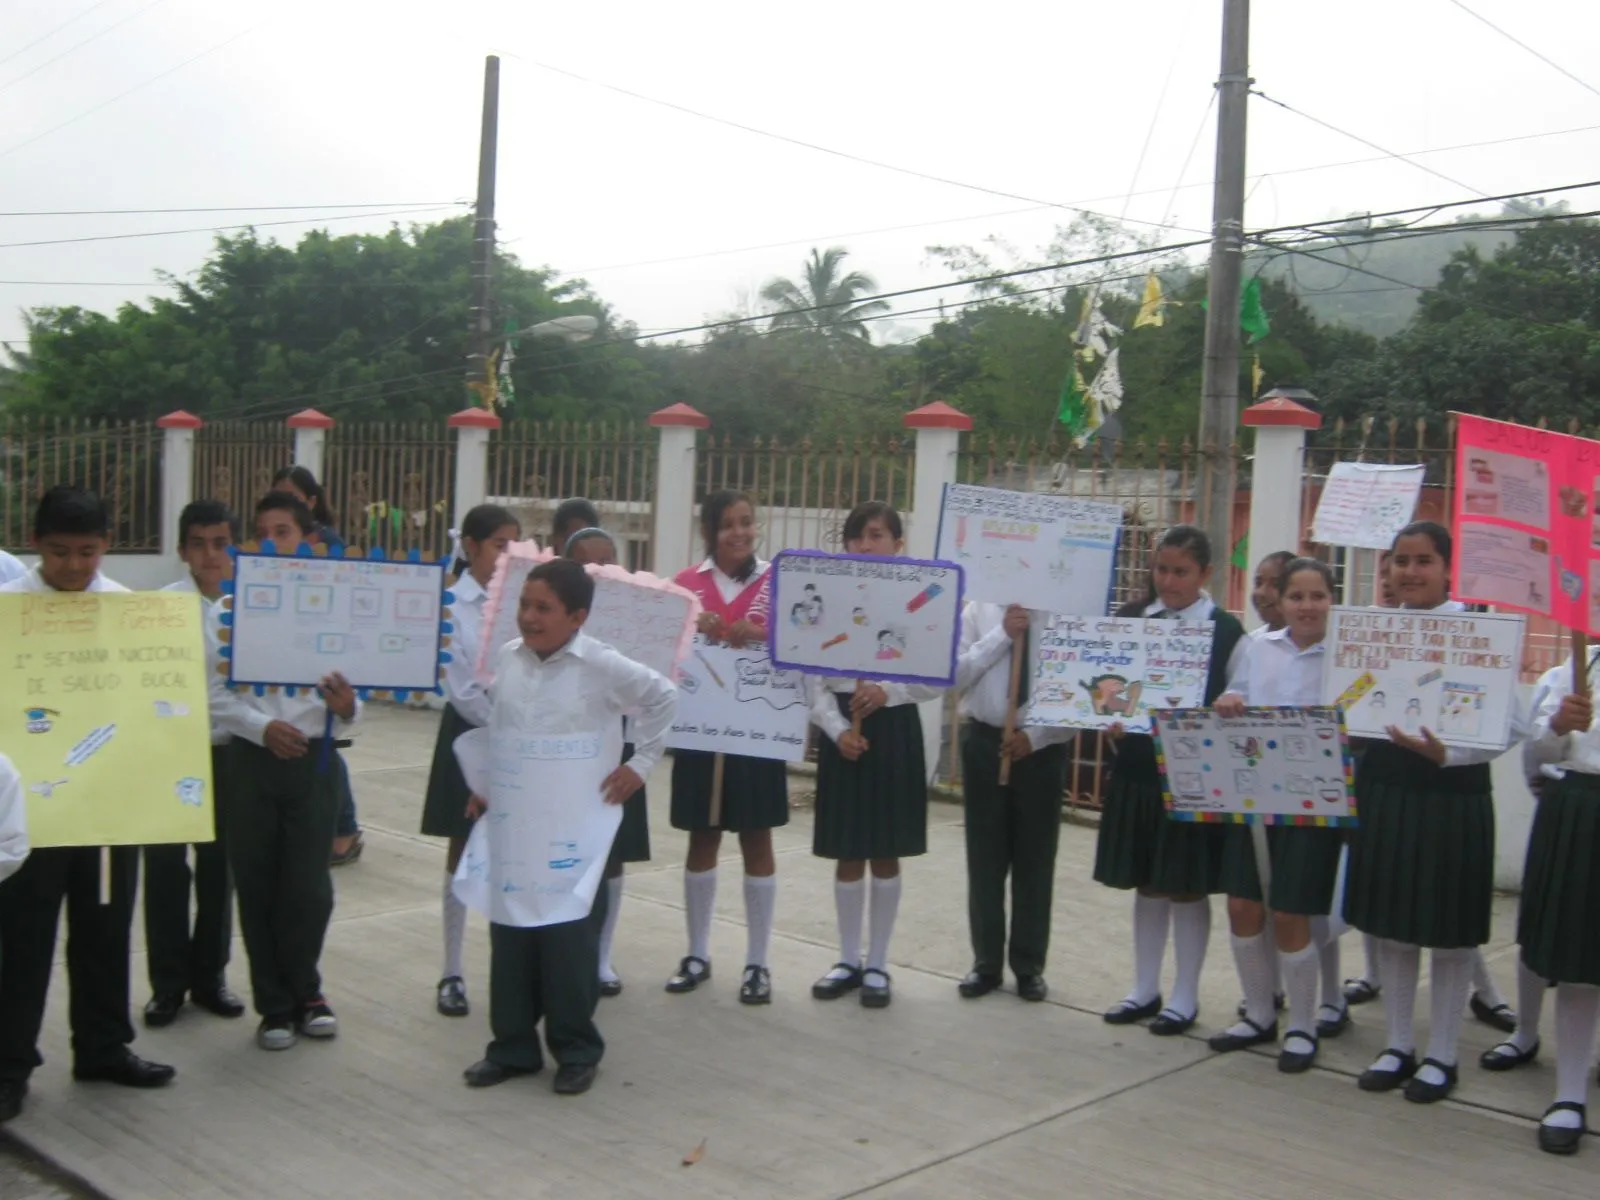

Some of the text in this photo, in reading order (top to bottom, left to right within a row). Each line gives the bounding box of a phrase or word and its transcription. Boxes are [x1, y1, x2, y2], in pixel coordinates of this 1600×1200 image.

[1096, 617, 1134, 634] entre
[1143, 620, 1165, 636] los
[1338, 614, 1382, 630] VISITE
[1400, 617, 1414, 631] SU
[1420, 618, 1476, 634] DENTISTA
[43, 647, 110, 668] SEMANA
[118, 645, 197, 663] NACIONAL
[27, 672, 188, 695] DE SALUD BUCAL
[702, 722, 718, 736] los
[749, 728, 765, 740] los
